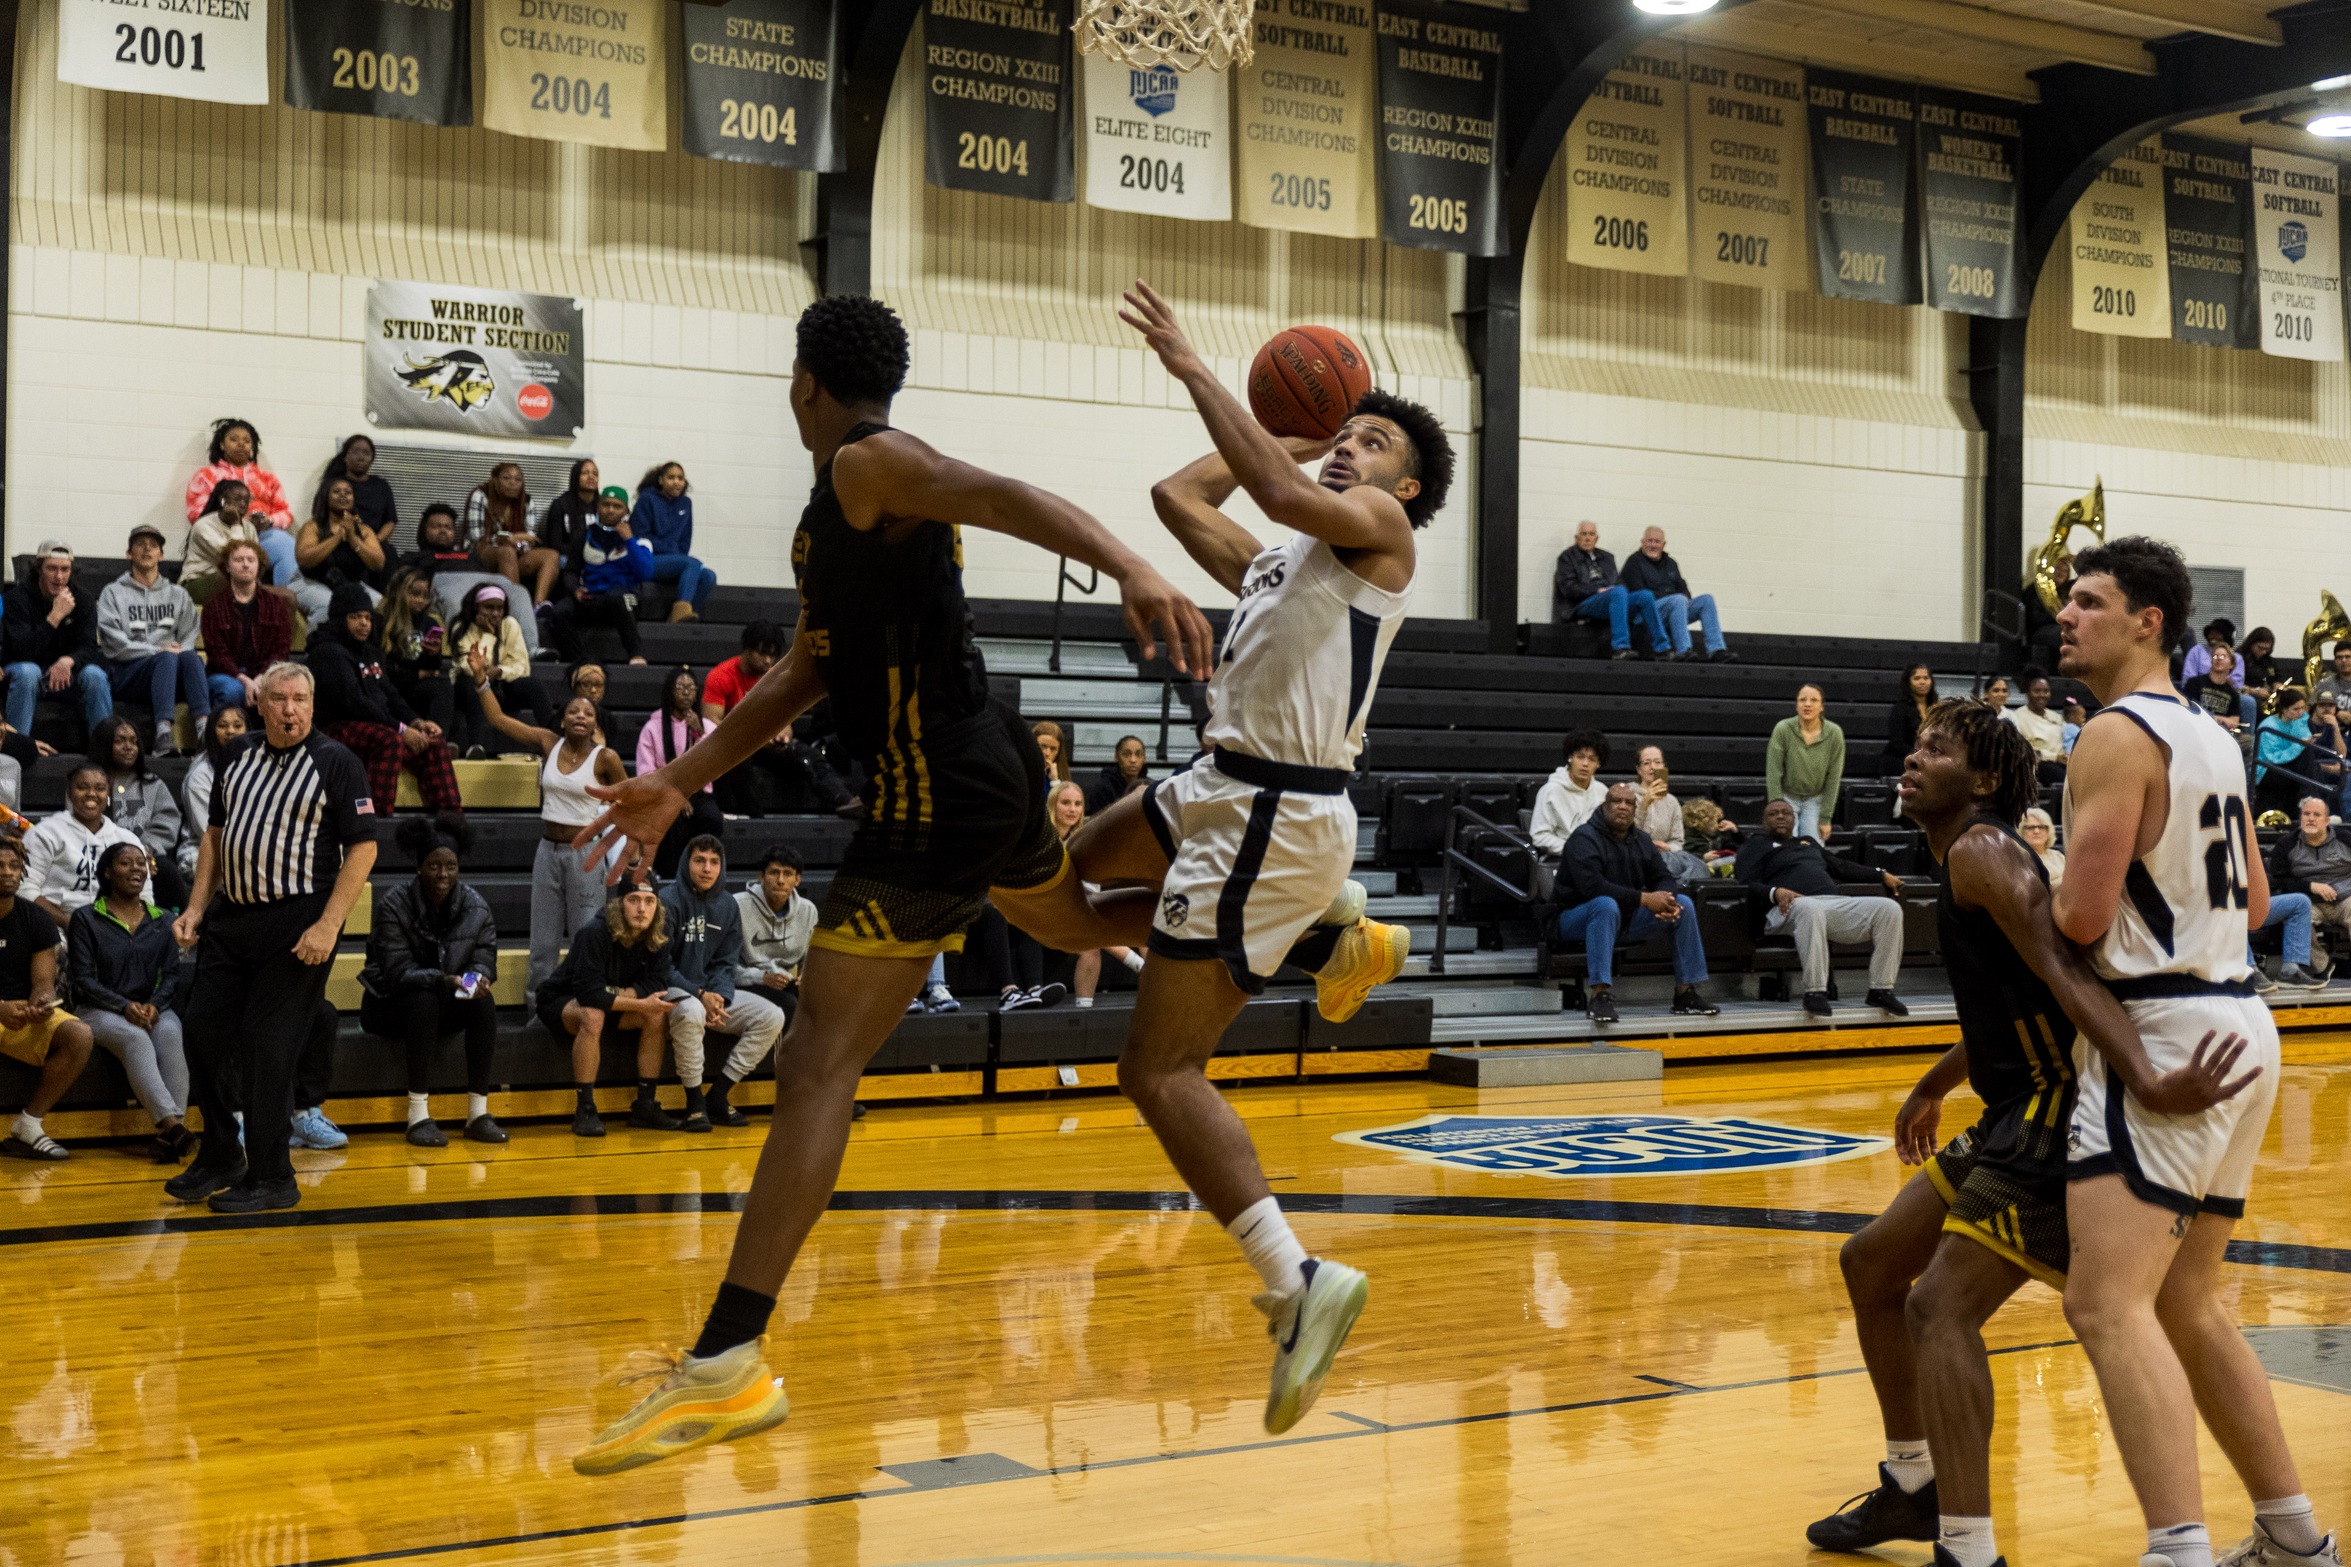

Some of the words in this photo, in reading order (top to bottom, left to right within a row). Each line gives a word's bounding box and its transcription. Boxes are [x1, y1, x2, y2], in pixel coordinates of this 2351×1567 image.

[158, 0, 250, 21] SIXTEEN
[518, 0, 629, 32] DIVISION
[930, 0, 1061, 36] BASKETBALL
[1288, 0, 1369, 28] CENTRAL
[500, 27, 646, 65] CHAMPIONS
[726, 17, 795, 46] STATE
[1257, 23, 1349, 56] SOFTBALL
[1377, 12, 1420, 39] EAST
[1426, 22, 1502, 54] CENTRAL
[115, 23, 206, 73] 2001
[690, 43, 828, 82] CHAMPIONS
[332, 47, 420, 97] 2003
[928, 45, 1009, 75] REGION
[1014, 59, 1060, 84] XXIII
[1398, 48, 1484, 81] BASEBALL
[1614, 55, 1681, 80] ENTRAL
[530, 73, 612, 119] 2004
[931, 75, 1056, 112] CHAMPIONS
[1261, 69, 1345, 98] CENTRAL
[1594, 80, 1664, 107] OFTBALL
[1690, 64, 1728, 88] EAST
[1733, 72, 1801, 102] CENTRAL
[1261, 96, 1343, 126] DIVISION
[1707, 96, 1784, 127] SOFTBALL
[1809, 86, 1845, 109] EAST
[1850, 92, 1914, 121] CENTRAL
[719, 98, 798, 146] 2004
[1095, 117, 1149, 141] ELITE
[1153, 124, 1211, 149] EIGHT
[1382, 105, 1451, 132] REGION
[1455, 117, 1493, 140] XXIII
[1585, 119, 1660, 146] CENTRAL
[1825, 117, 1898, 145] BASEBALL
[1920, 103, 1957, 127] EAST
[1959, 111, 2022, 137] CENTRAL
[958, 131, 1029, 177] 2004
[1247, 122, 1357, 154] CHAMPIONS
[1386, 133, 1491, 165] CHAMPIONS
[1710, 139, 1780, 164] CENTRAL
[1586, 145, 1659, 171] DIVISION
[1927, 153, 2014, 183] BASKETBALL
[2195, 156, 2250, 180] CENTRAL
[1120, 155, 1185, 195] 2004
[1572, 169, 1671, 198] CHAMPIONS
[1710, 163, 1779, 189] DIVISION
[1840, 176, 1885, 197] STATE
[2173, 178, 2235, 203] SOFTBALL
[2284, 170, 2336, 195] CENTRAL
[1270, 172, 1332, 212] 2005
[1697, 186, 1791, 216] CHAMPIONS
[1926, 196, 1981, 217] REGION
[2263, 193, 2323, 217] SOFTBALL
[1409, 194, 1469, 235] 2005
[1818, 196, 1905, 223] CHAMPIONS
[2092, 202, 2134, 222] SOUTH
[1594, 215, 1649, 252] 2006
[1716, 231, 1769, 267] 2007
[2086, 224, 2141, 245] DIVISION
[1838, 250, 1887, 285] 2007
[2075, 245, 2154, 268] CHAMPIONS
[1947, 264, 1996, 298] 2008
[2258, 268, 2296, 286] ATIONAL
[2296, 272, 2339, 292] TOURNEY
[430, 299, 525, 326] WARRIOR
[2093, 285, 2136, 317] 2010
[2184, 298, 2227, 331] 2010
[2286, 292, 2317, 311] PLACE
[383, 318, 477, 346] STUDENT
[484, 328, 570, 355] SECTION
[2274, 313, 2313, 342] 2010
[1277, 340, 1336, 415] SPALDING
[128, 603, 175, 621] SENIOR
[2198, 791, 2249, 912] 20
